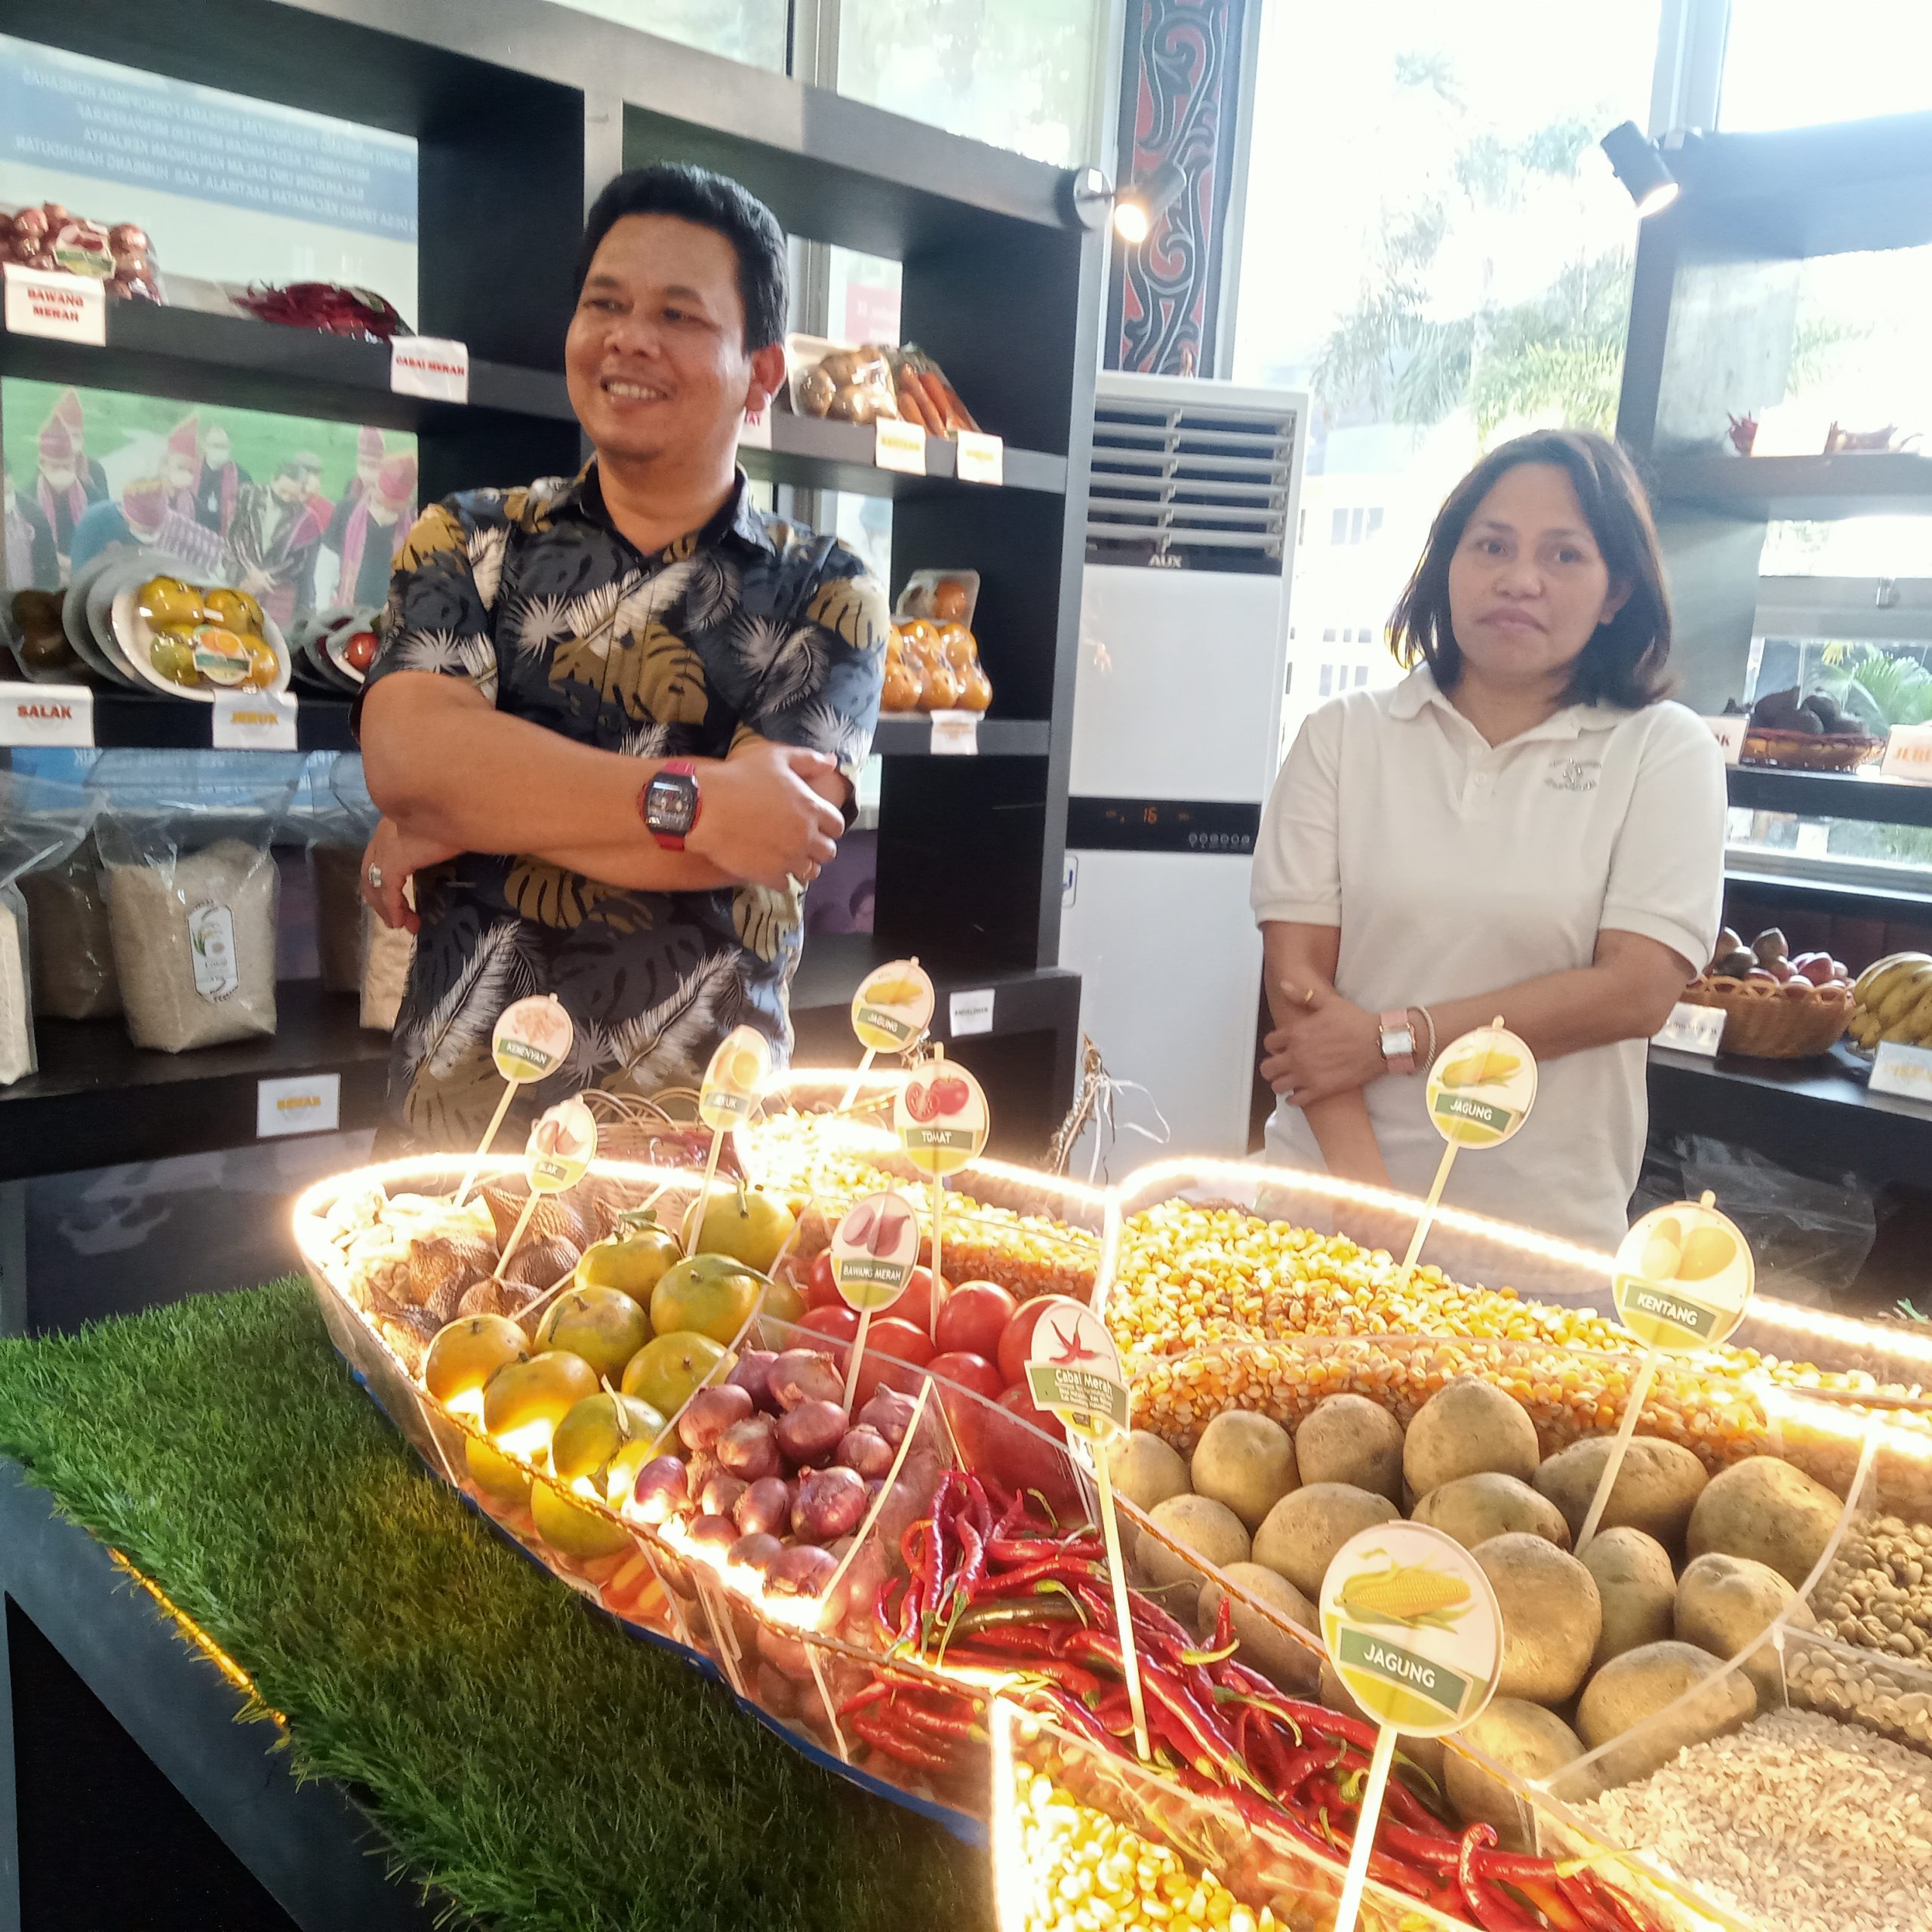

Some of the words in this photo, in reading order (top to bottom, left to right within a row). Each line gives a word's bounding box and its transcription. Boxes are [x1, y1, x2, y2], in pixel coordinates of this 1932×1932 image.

[27, 288, 84, 306] BAWANG
[32, 306, 79, 322] MERAH
[1148, 554, 1183, 568] AUX
[1450, 1099, 1492, 1121] JAGUNG
[921, 1131, 952, 1144] TOMAT
[844, 1265, 873, 1278] BAWANG
[875, 1268, 901, 1281] MERAH
[1637, 1292, 1698, 1326] KENTANG
[1084, 1374, 1112, 1397] Merah
[1364, 1644, 1435, 1688] JAGUNG
